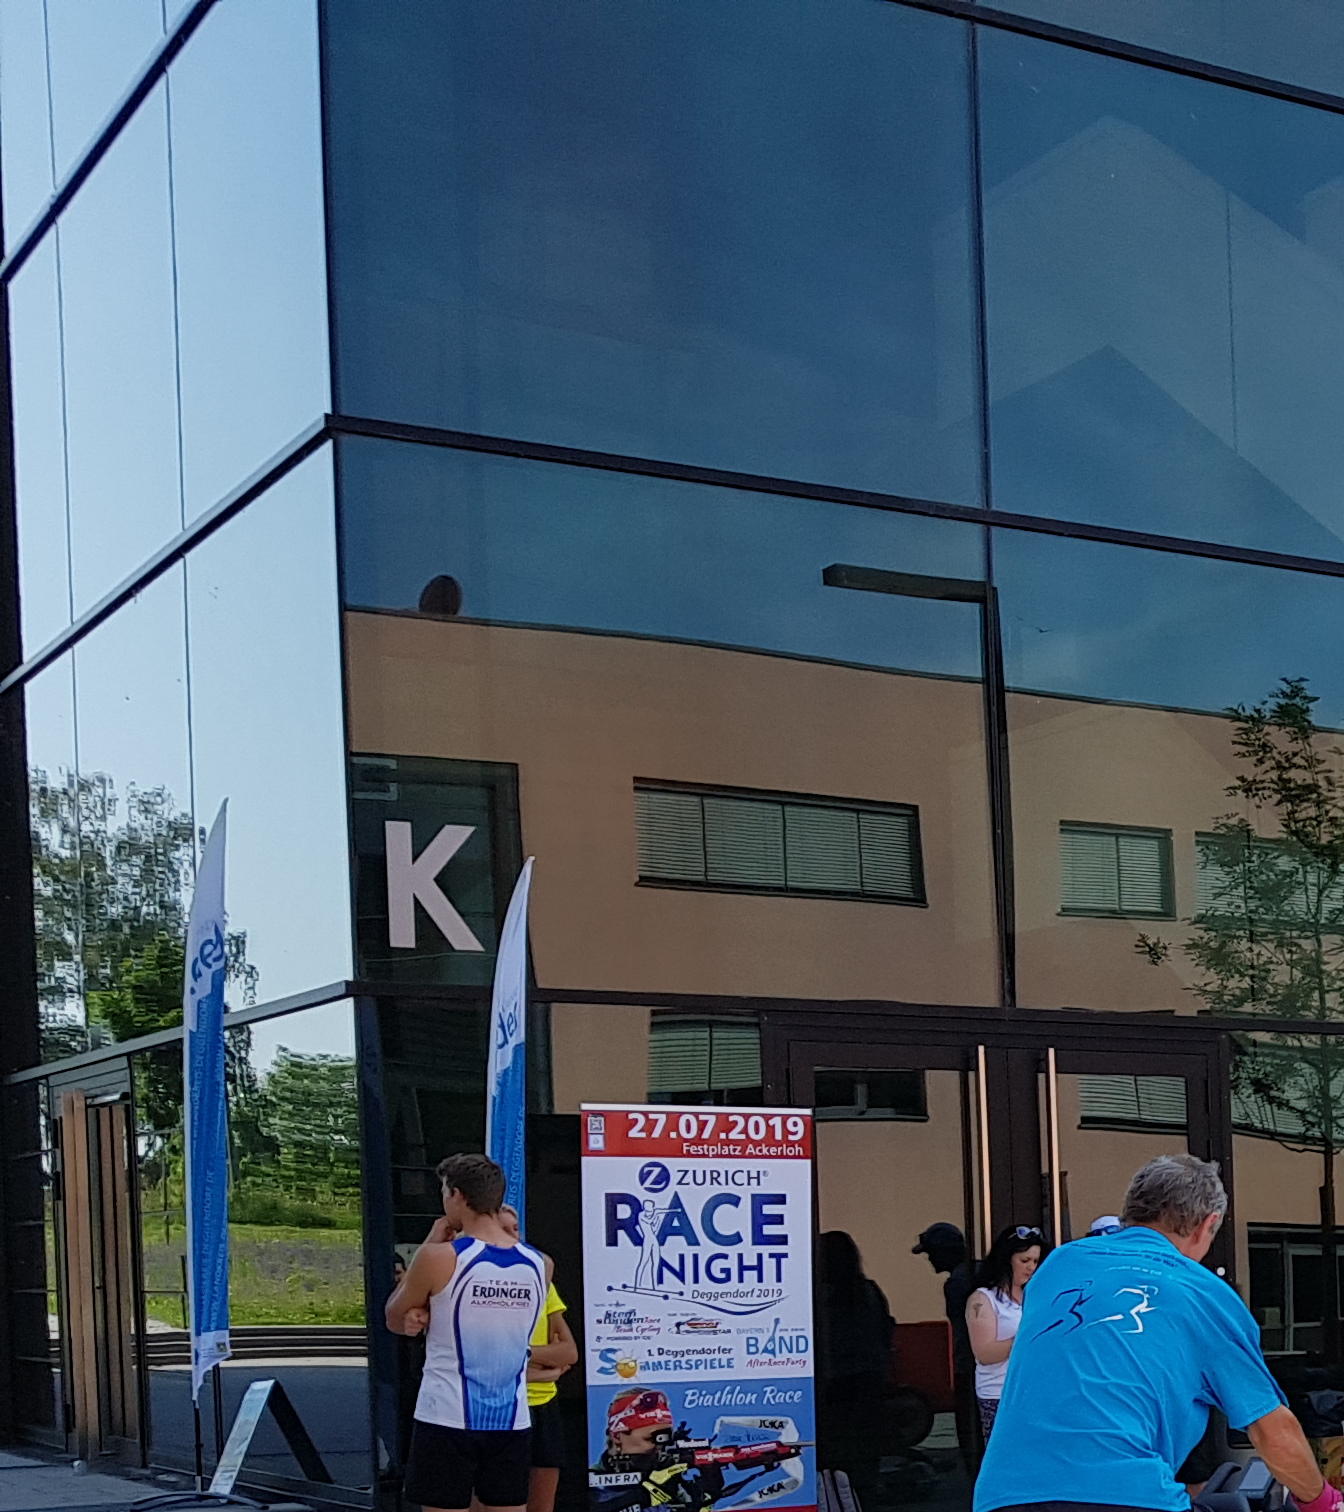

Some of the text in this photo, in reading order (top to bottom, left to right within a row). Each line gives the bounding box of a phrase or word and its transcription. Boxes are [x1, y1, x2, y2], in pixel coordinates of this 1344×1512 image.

[385, 820, 485, 952] K
[627, 1112, 805, 1141] 27.07.2019
[683, 1143, 803, 1157] Festplatz Ackerloh
[604, 1191, 789, 1247] RACE
[657, 1252, 789, 1286] NIGHT
[472, 1285, 531, 1301] ERDINGER
[692, 1287, 783, 1302] Deggendorf 2019
[657, 1346, 734, 1358] Deggendorfer
[746, 1334, 809, 1358] BAND
[684, 1386, 802, 1409] Biathlon Race
